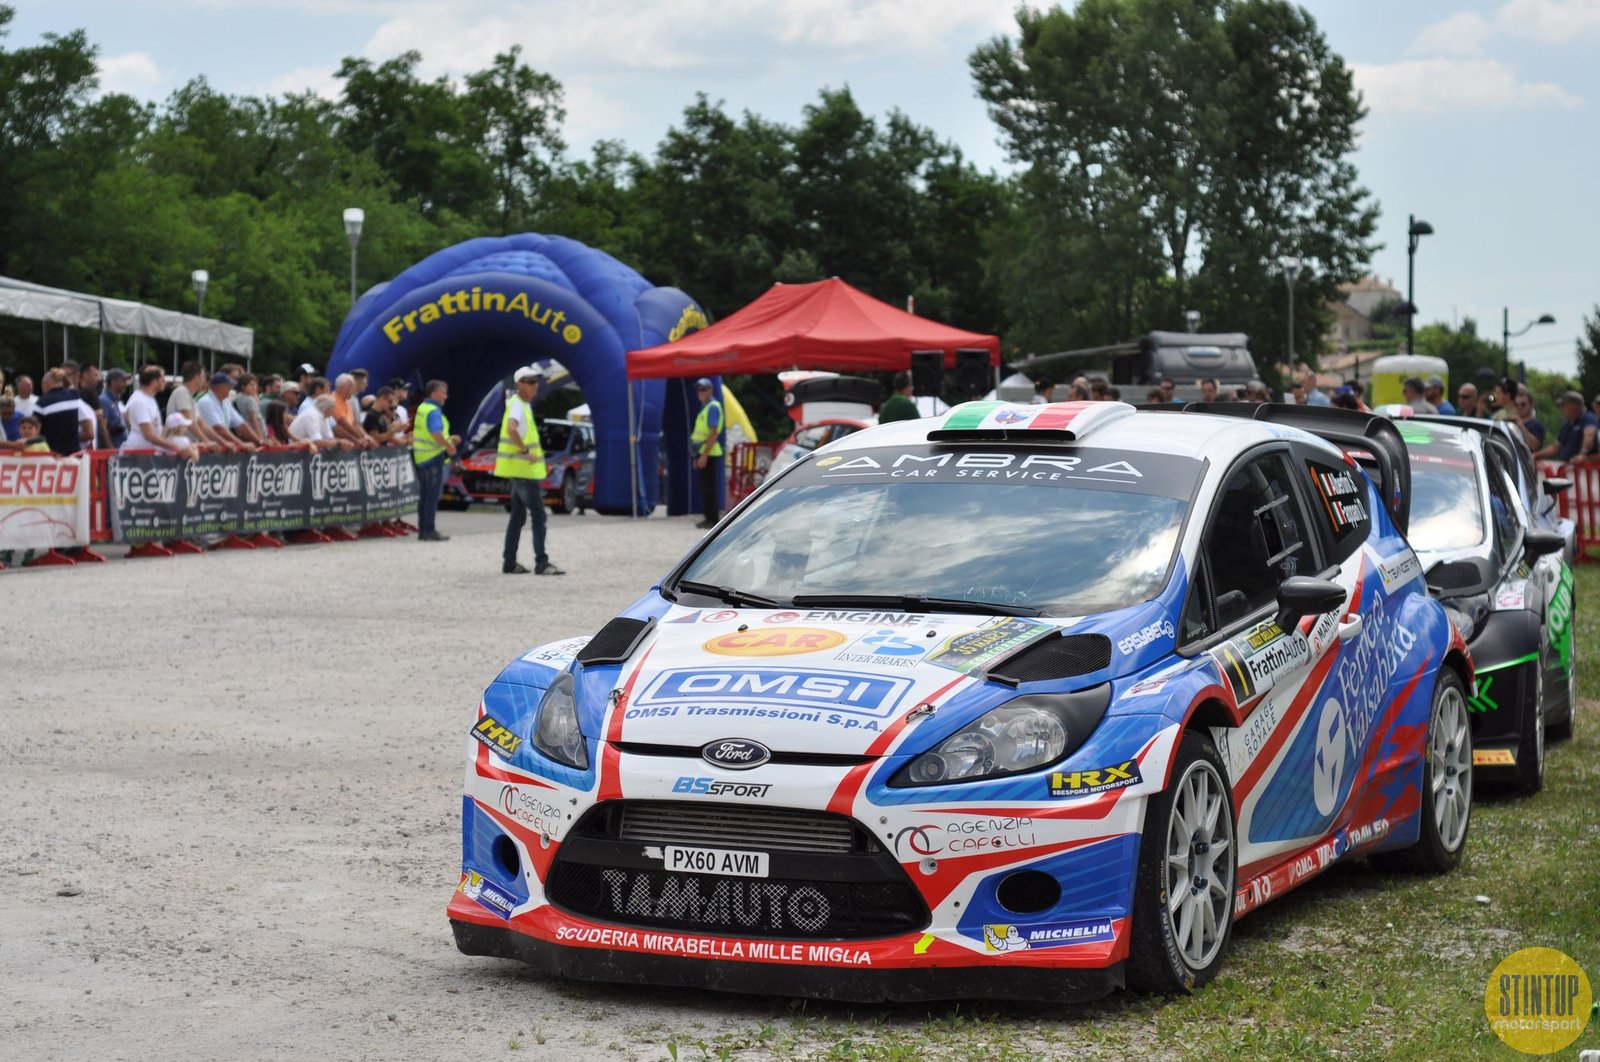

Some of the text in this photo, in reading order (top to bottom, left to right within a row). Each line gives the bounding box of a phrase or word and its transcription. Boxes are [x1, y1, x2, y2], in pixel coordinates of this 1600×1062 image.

[382, 286, 582, 345] FrattinAuto
[309, 453, 361, 500] freem
[828, 452, 1144, 477] AMBRA
[890, 469, 1062, 481] CAR SERVICE
[184, 458, 239, 507] freem
[246, 455, 303, 503] freem
[802, 611, 925, 626] ENGINE
[717, 632, 826, 649] CAR
[1338, 589, 1385, 719] Ferriera
[835, 652, 916, 668] INTER BRAKES
[1223, 648, 1250, 697] 1
[1248, 637, 1307, 682] FrattinAuto
[688, 673, 873, 703] OMSI
[625, 703, 883, 732] OMSI Trasmissioni S.p.A.
[1244, 698, 1274, 747] GARAGE
[477, 718, 522, 753] HRX
[1248, 712, 1277, 759] ROYALE
[715, 741, 753, 761] Ford
[1052, 761, 1133, 789] HRX
[1090, 776, 1139, 793] MOTORSPORT
[519, 793, 561, 820] AGENZIA
[947, 817, 1033, 835] AGENZIA
[673, 849, 760, 874] PX60 AVM
[482, 888, 516, 912] MICHELIN
[555, 926, 872, 965] SCUDERIA MIRABELLA MILLE MIGLIA
[1030, 923, 1111, 941] MICHELIN
